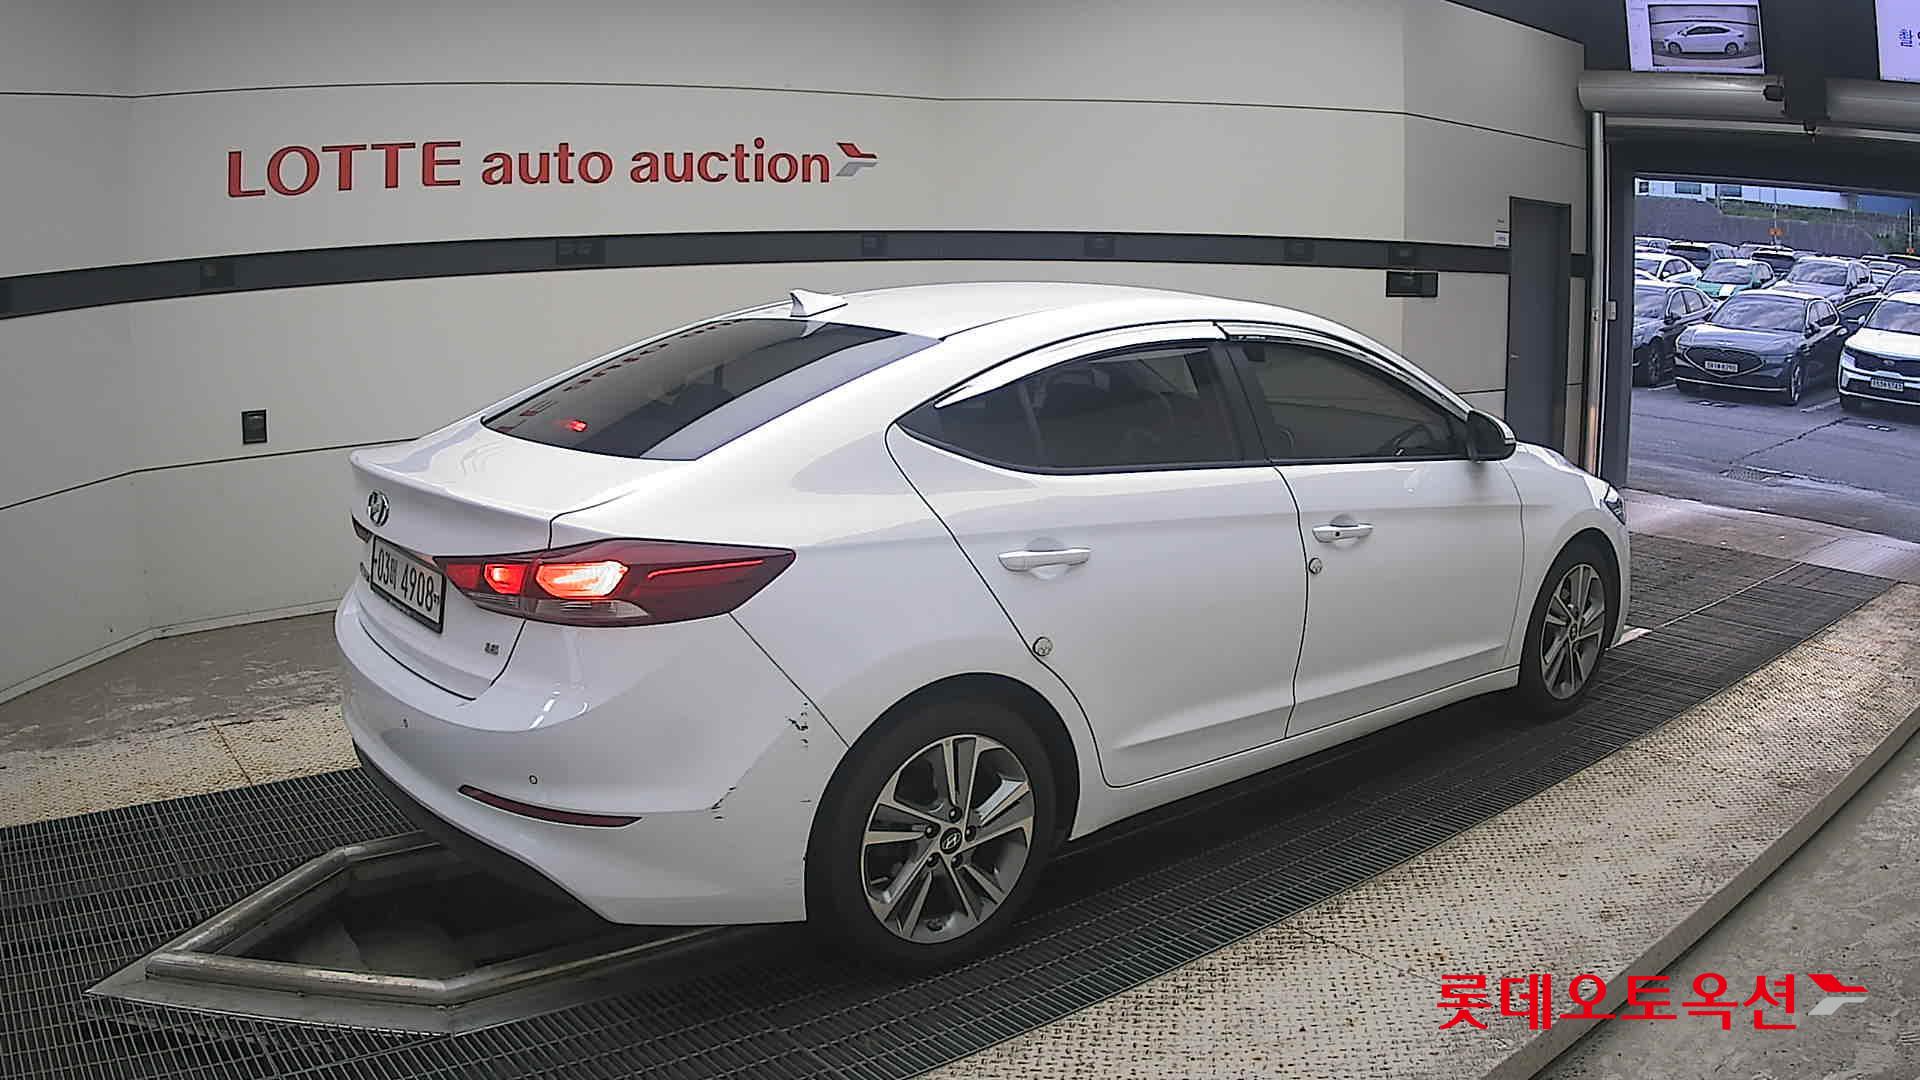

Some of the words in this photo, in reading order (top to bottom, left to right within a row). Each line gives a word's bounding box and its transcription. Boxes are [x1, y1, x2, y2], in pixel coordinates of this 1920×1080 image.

[228, 142, 461, 198] LOTTE
[482, 143, 613, 186] auto
[631, 137, 829, 183] auction
[401, 564, 434, 611] 4908
